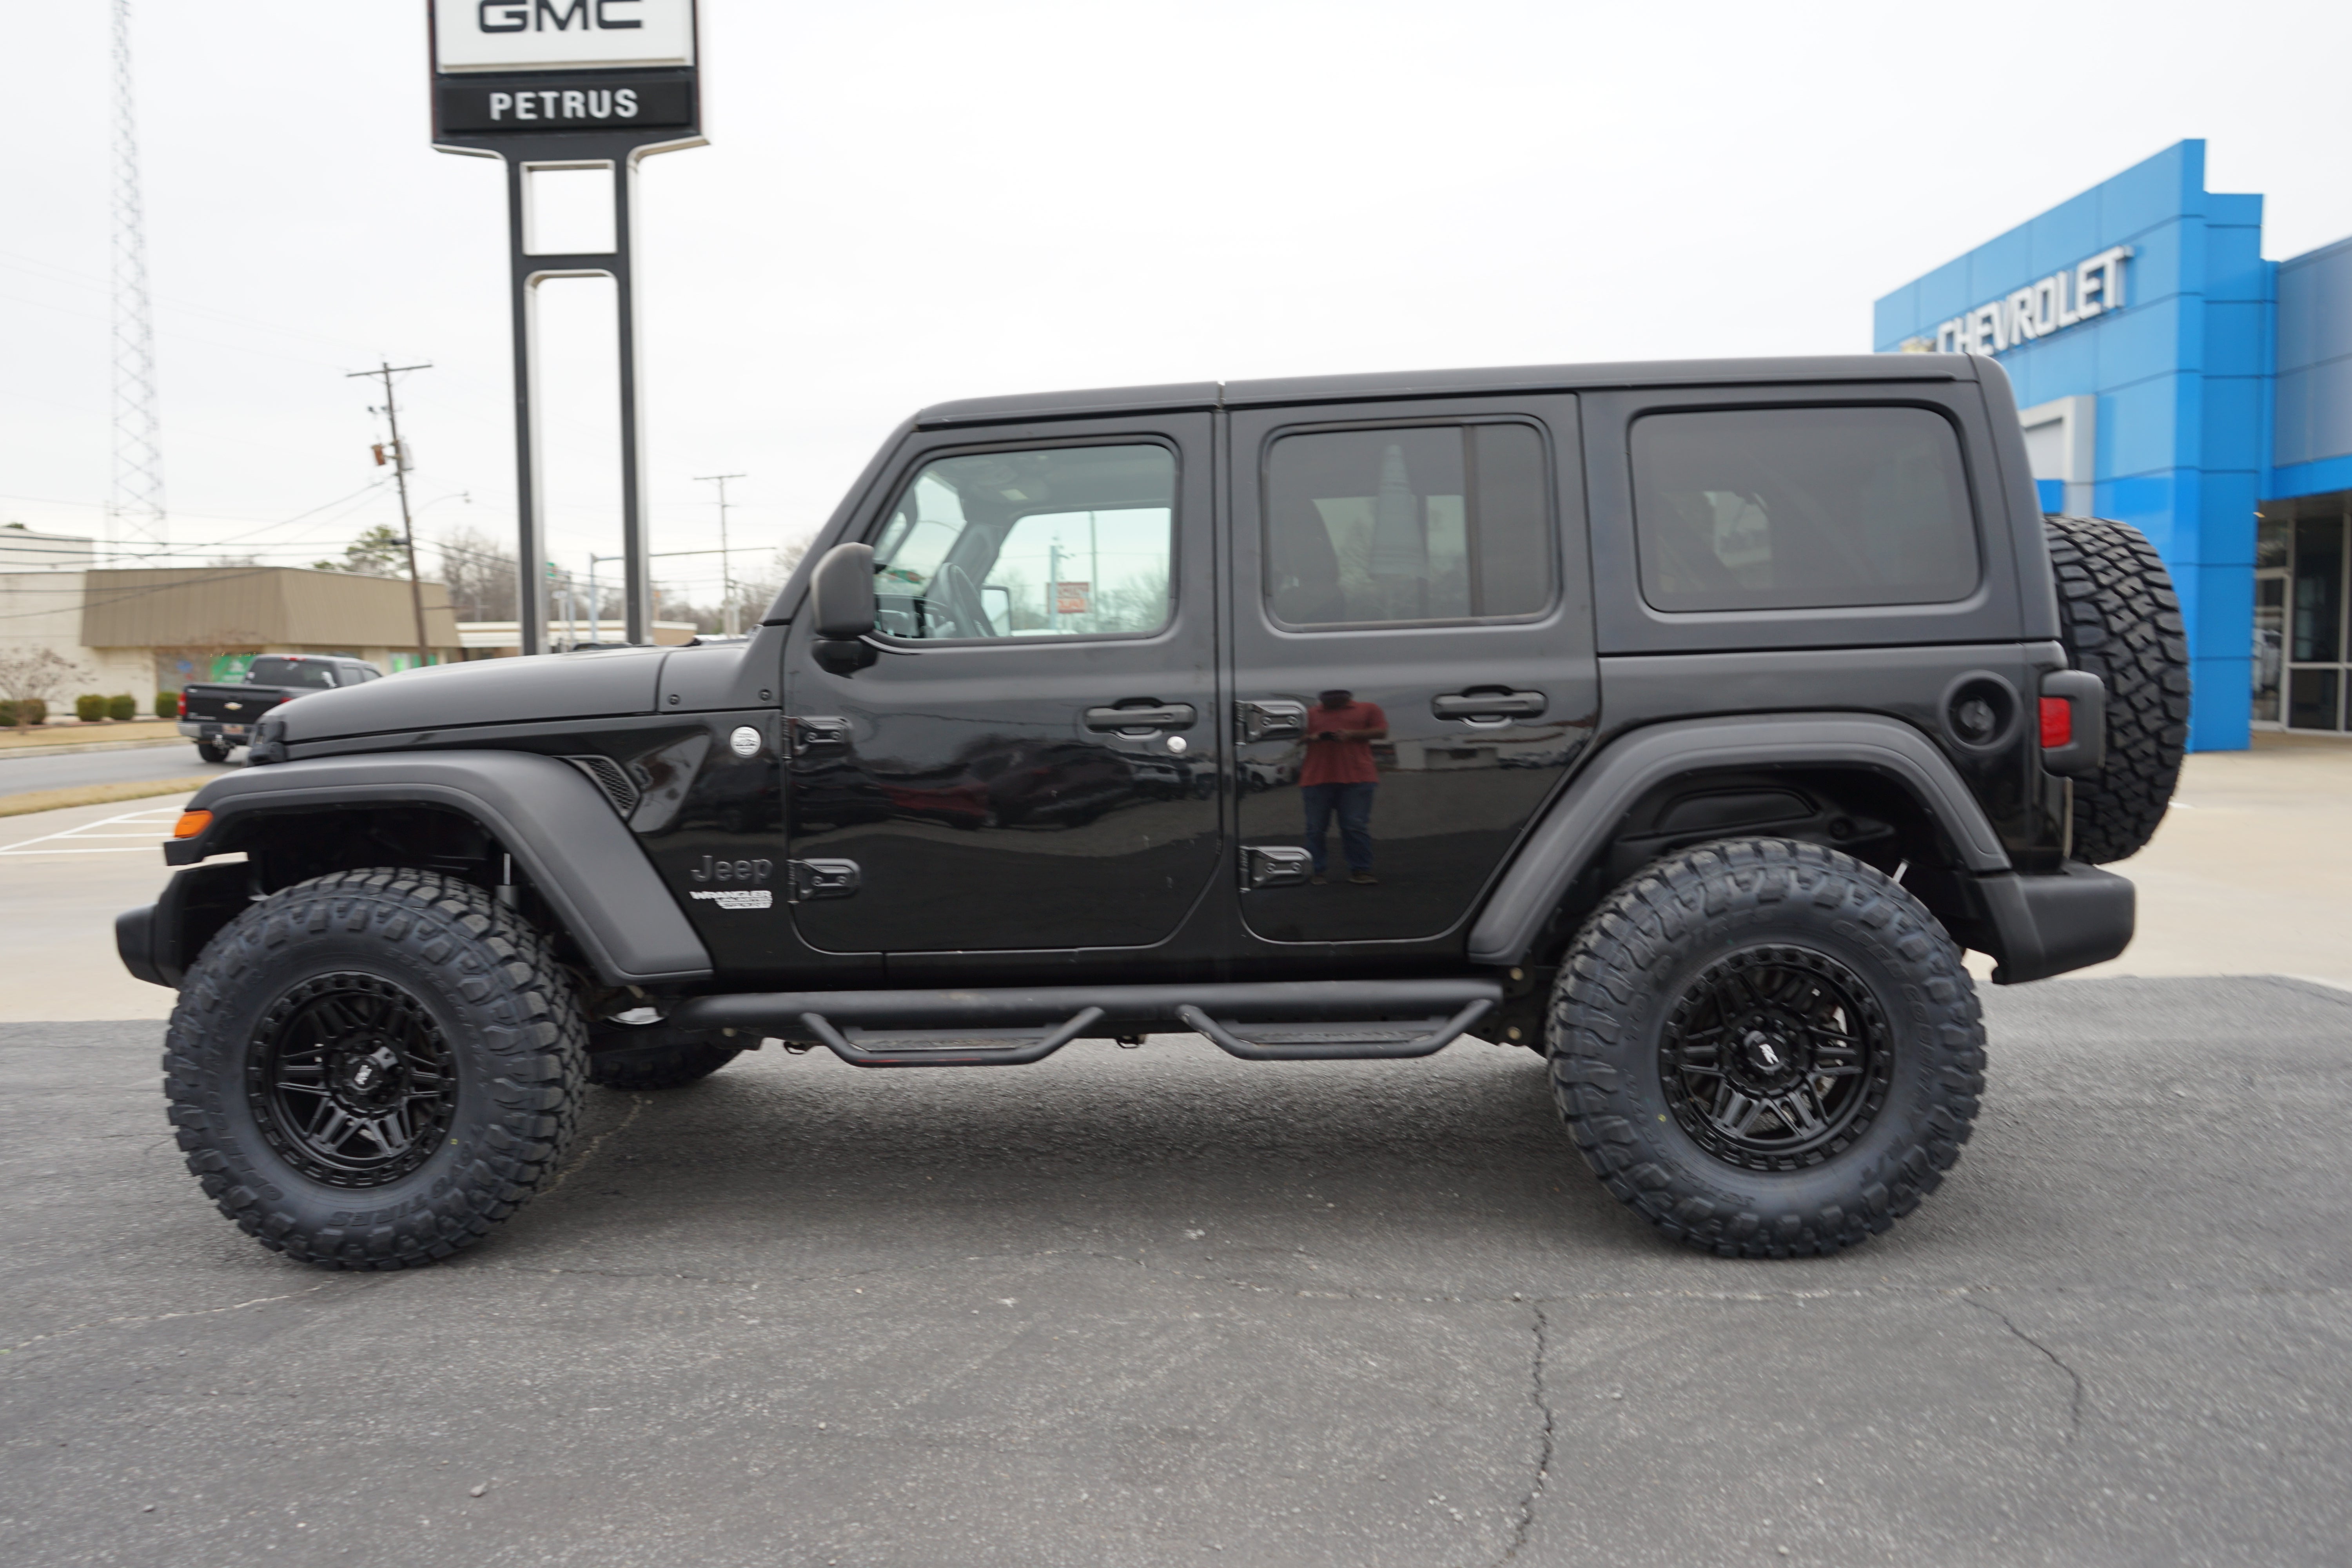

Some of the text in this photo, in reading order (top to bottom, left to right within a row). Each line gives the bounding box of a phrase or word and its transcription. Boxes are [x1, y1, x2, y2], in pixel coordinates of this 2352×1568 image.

[479, 0, 643, 33] GMC
[490, 89, 639, 120] PETRUS
[1936, 245, 2135, 355] CHEVROLET
[690, 855, 773, 886] Jeep
[689, 890, 773, 900] WRANGLER
[327, 1192, 427, 1226] TIRES
